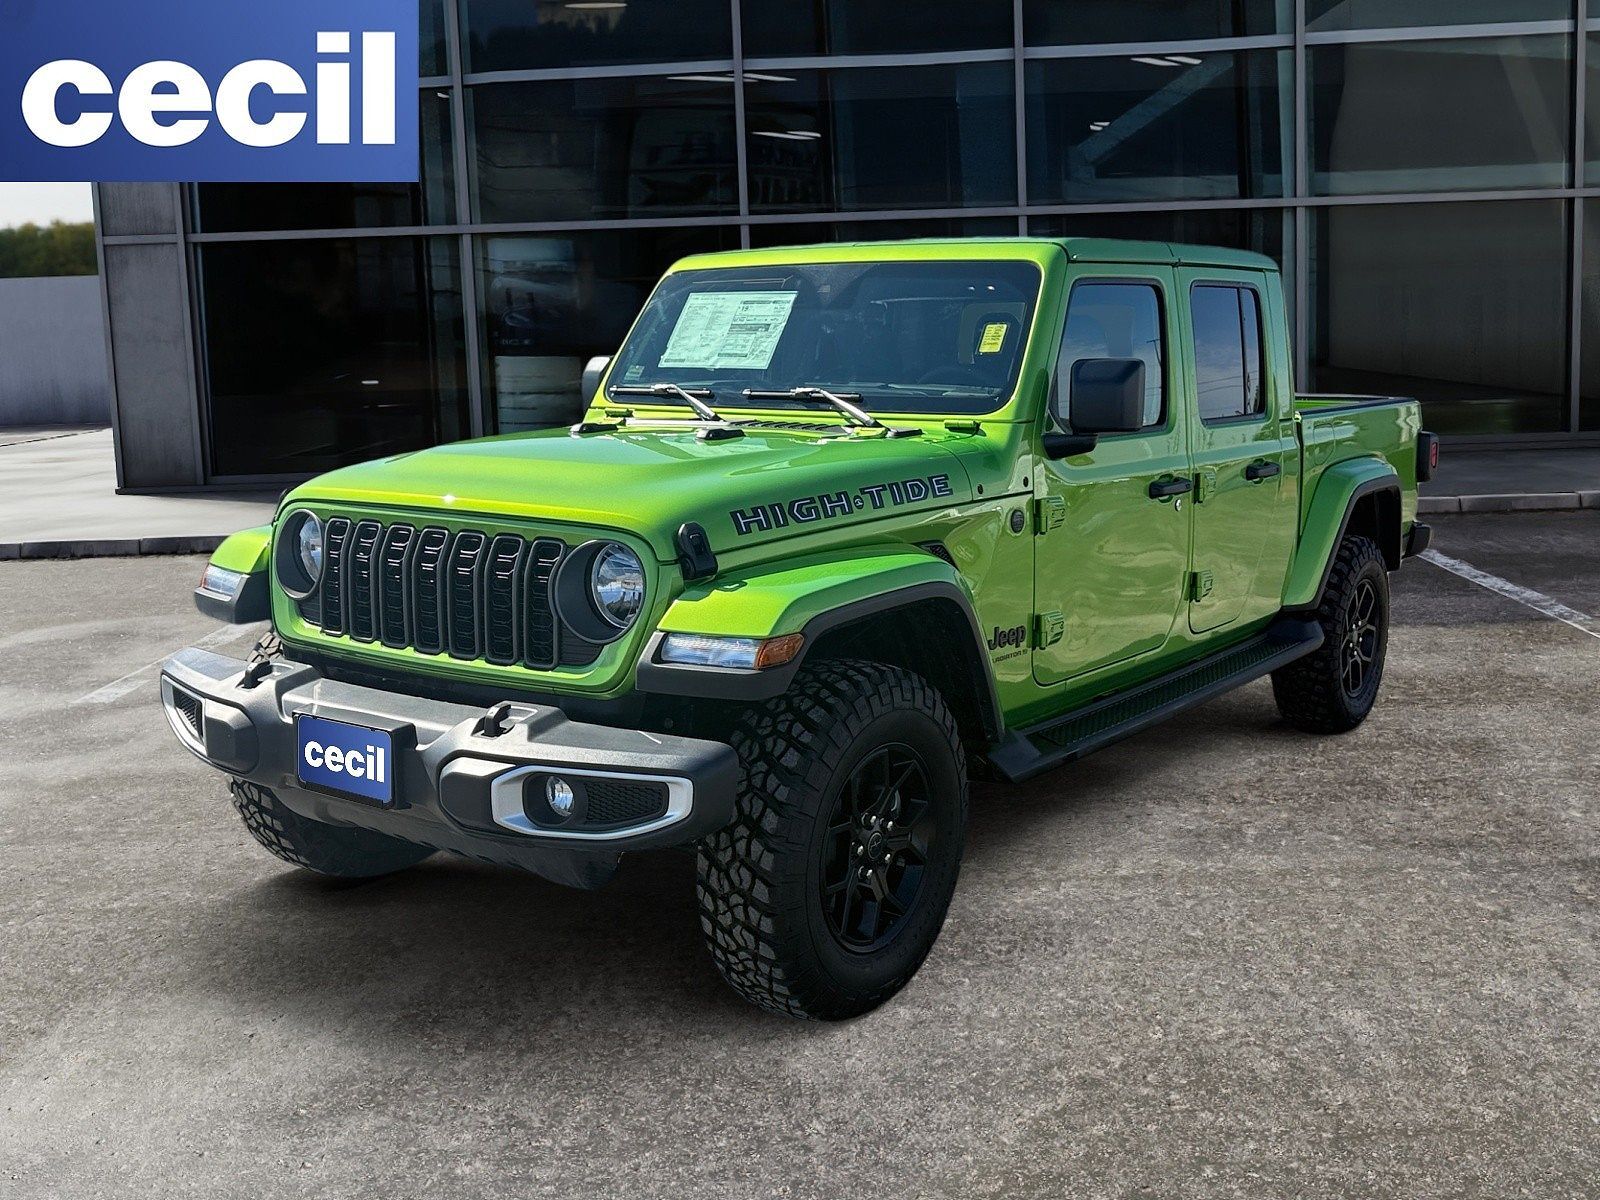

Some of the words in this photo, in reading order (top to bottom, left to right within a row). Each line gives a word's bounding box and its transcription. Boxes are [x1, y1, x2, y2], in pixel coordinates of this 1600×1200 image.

[729, 490, 854, 536] HIGH
[859, 473, 954, 509] TIDE
[987, 625, 1026, 650] Jeep
